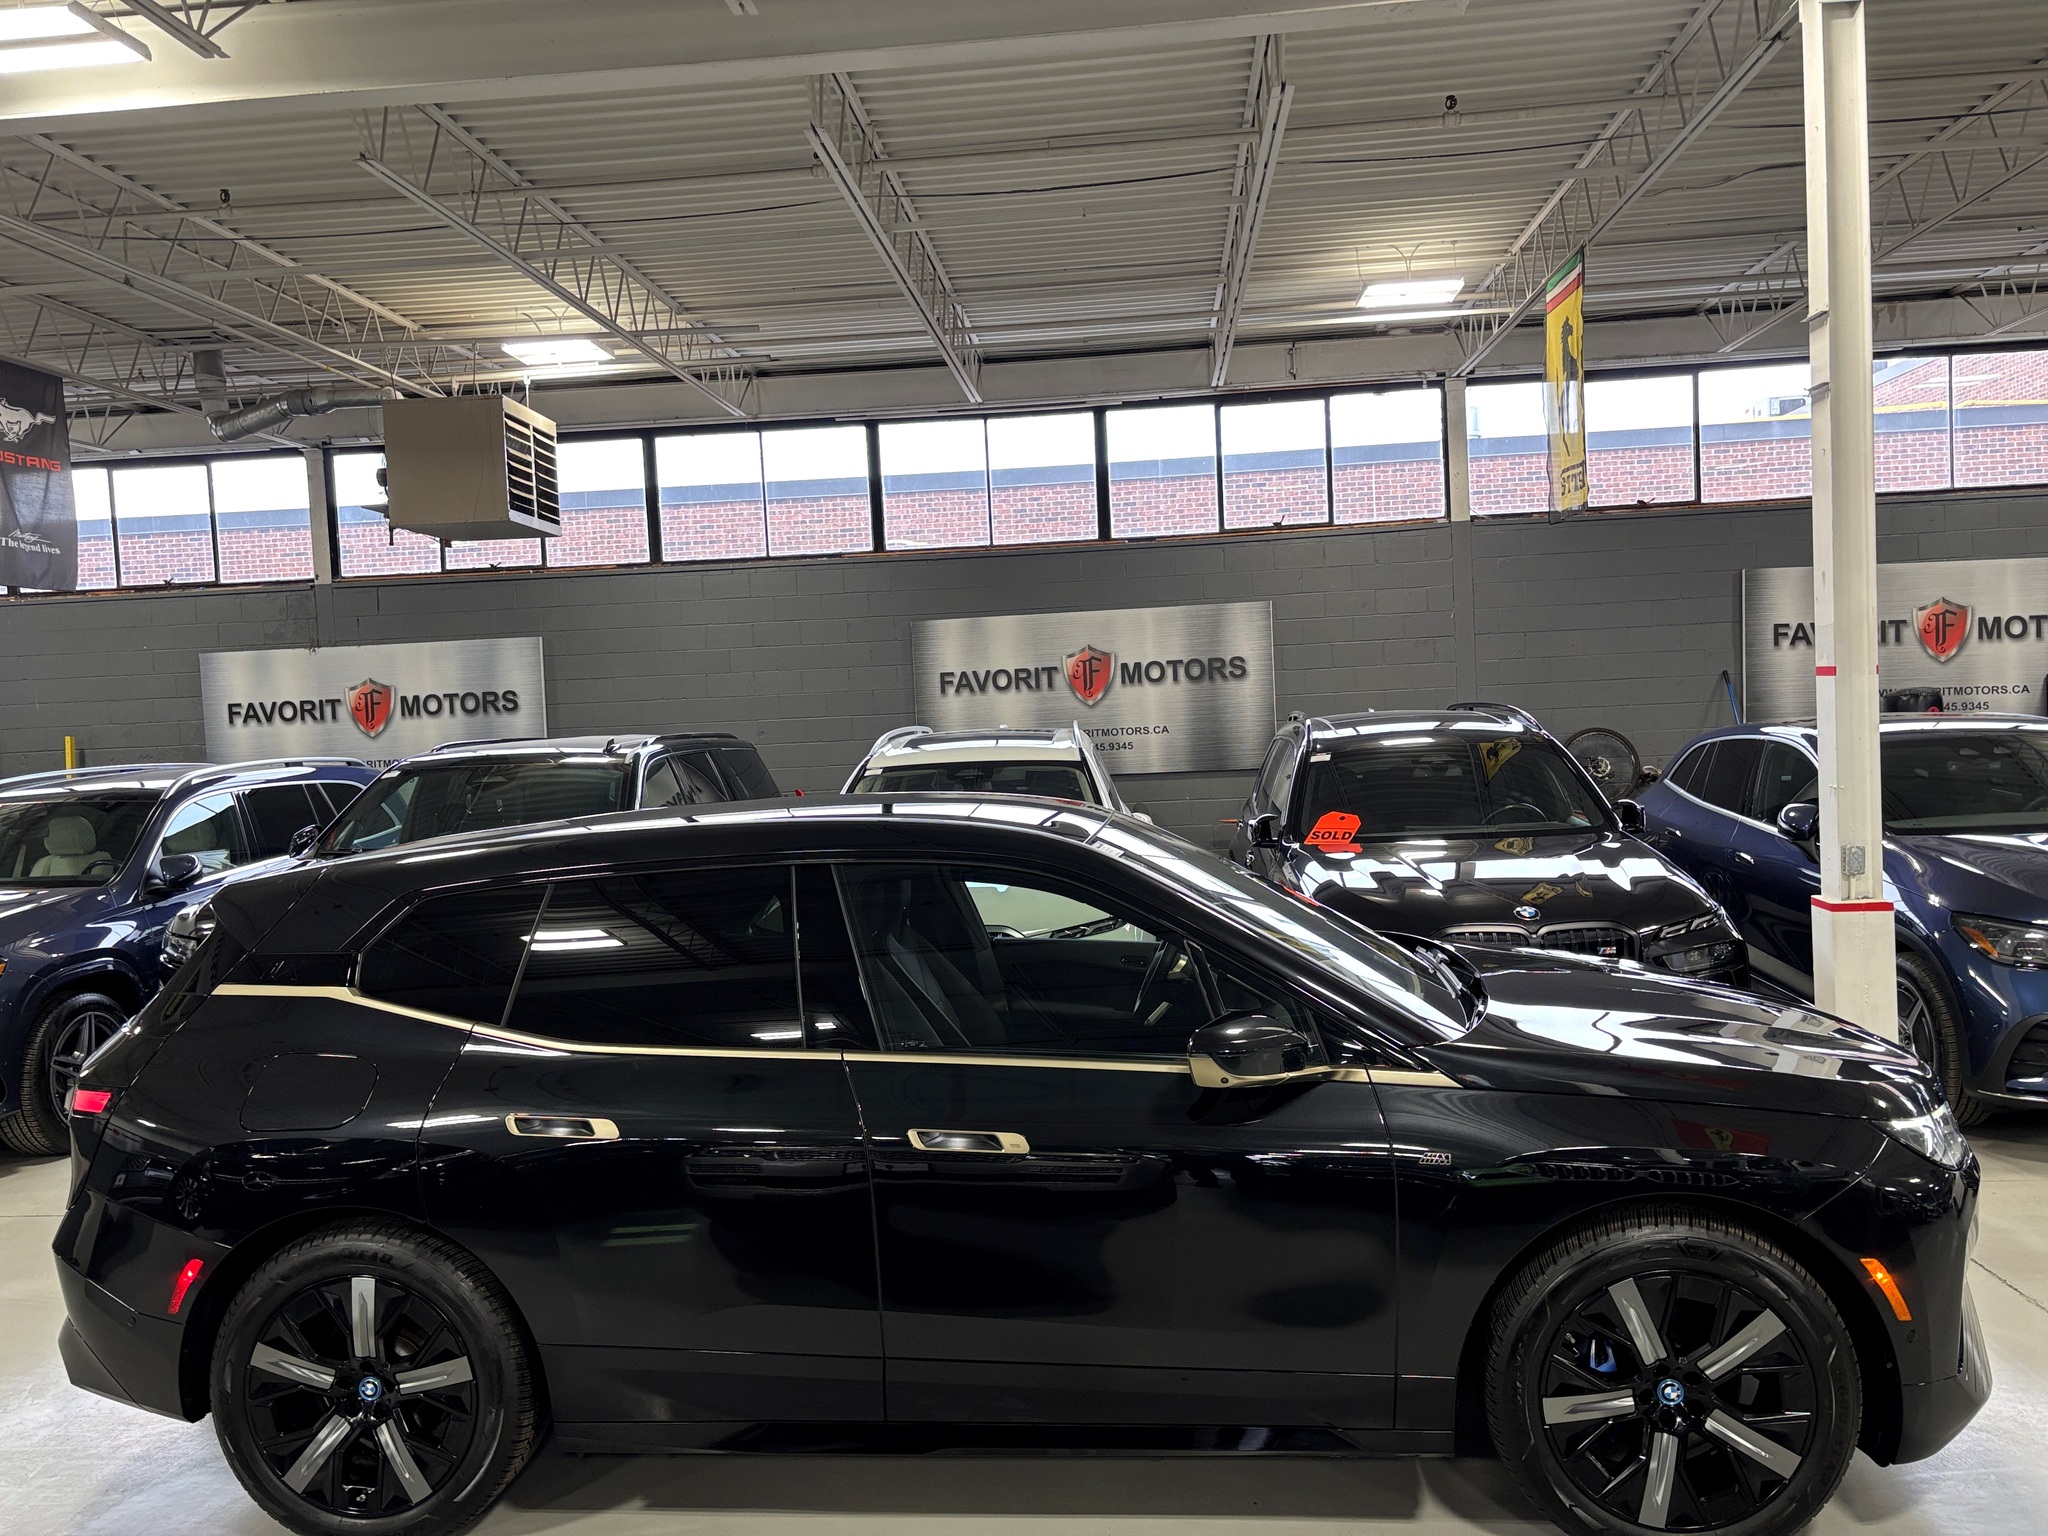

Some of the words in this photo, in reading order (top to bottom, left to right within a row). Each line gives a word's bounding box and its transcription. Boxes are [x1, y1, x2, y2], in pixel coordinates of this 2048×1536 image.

[0, 536, 19, 548] The
[20, 540, 41, 552] legend
[42, 544, 61, 555] lives
[940, 666, 1058, 693] FAVORIT
[1120, 656, 1247, 684] MOTORS
[227, 699, 341, 724] FAVORIT
[400, 690, 519, 716] MOTORS
[1943, 701, 1990, 711] 45.9345
[1083, 725, 1169, 738] RITMOTORS.CA
[1310, 831, 1353, 840] SOLD
